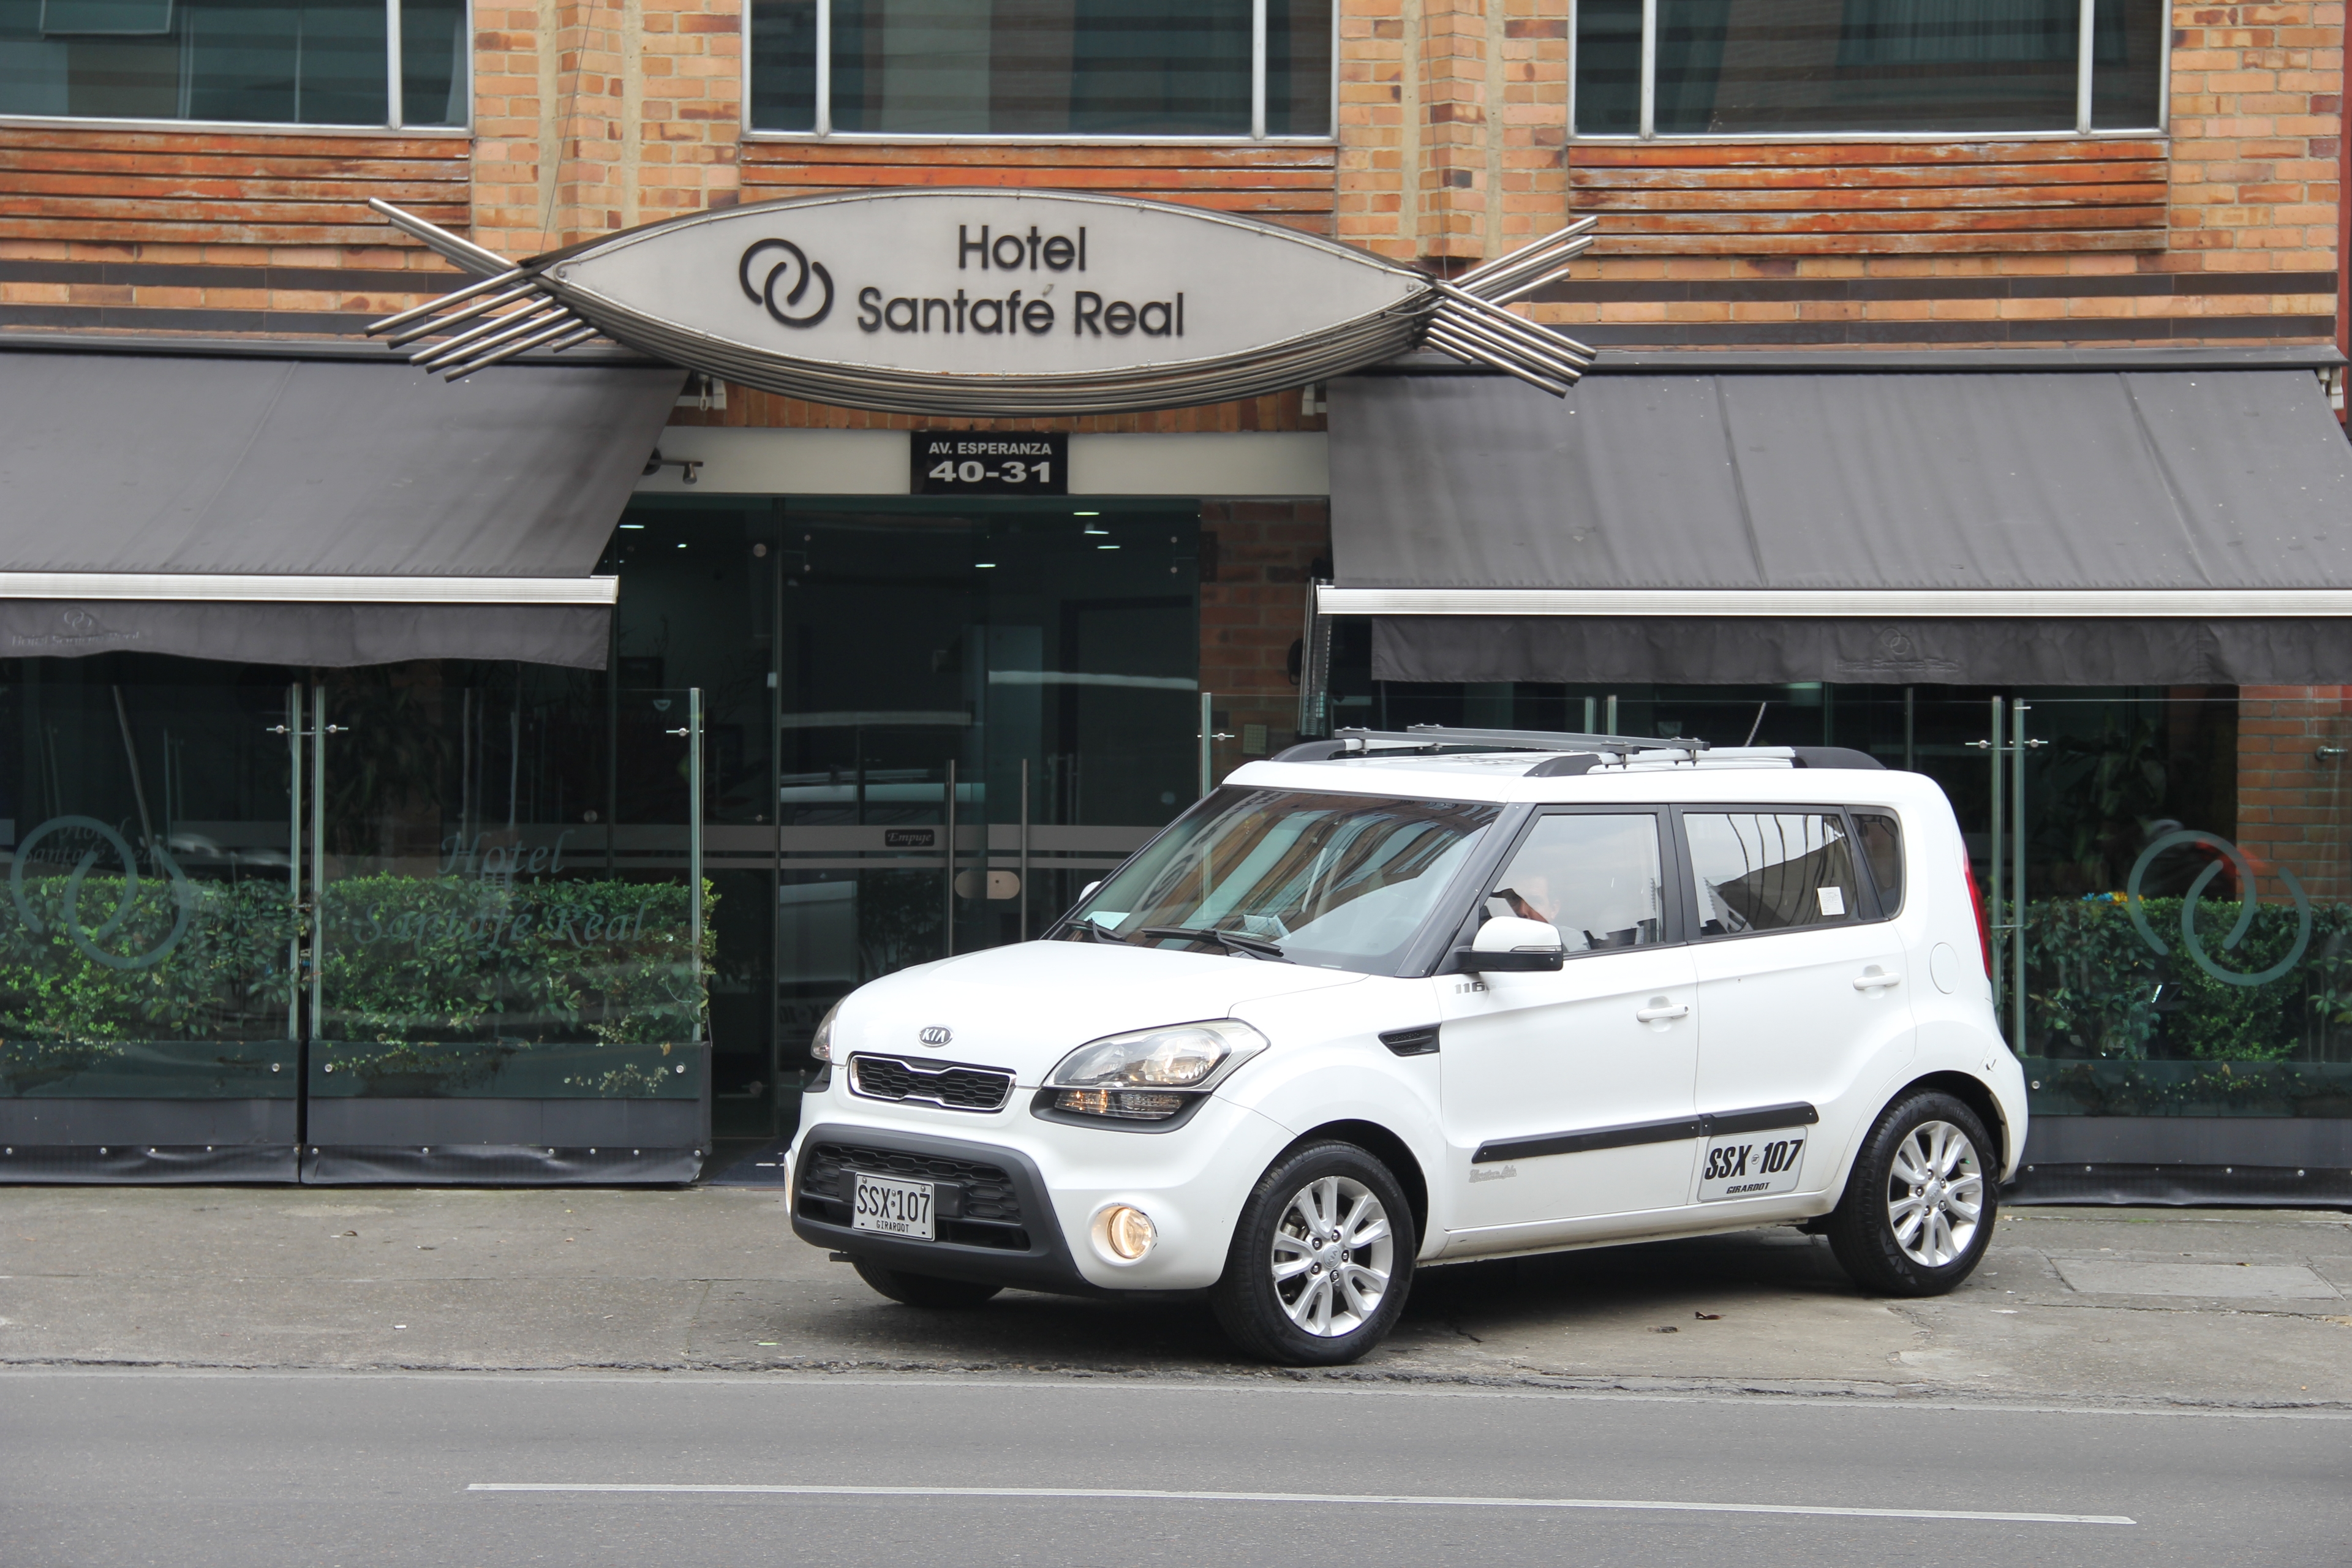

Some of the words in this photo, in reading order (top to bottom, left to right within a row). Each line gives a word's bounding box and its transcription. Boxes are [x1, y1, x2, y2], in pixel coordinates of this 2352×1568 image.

[959, 225, 1086, 271] Hotel
[858, 284, 1055, 334] Santafé
[1075, 291, 1185, 337] Real
[929, 442, 952, 456] AV.
[957, 442, 1052, 456] ESPERANZA
[928, 460, 1051, 484] 40-31
[888, 832, 932, 845] Empuje
[437, 829, 575, 875] Hotel
[354, 897, 533, 956] Santafé
[546, 896, 658, 950] Real
[922, 1027, 946, 1044] KIA
[1759, 1139, 1804, 1174] 107
[1726, 1182, 1771, 1194] GIRARDOT
[876, 1219, 910, 1233] GIRARDOT
